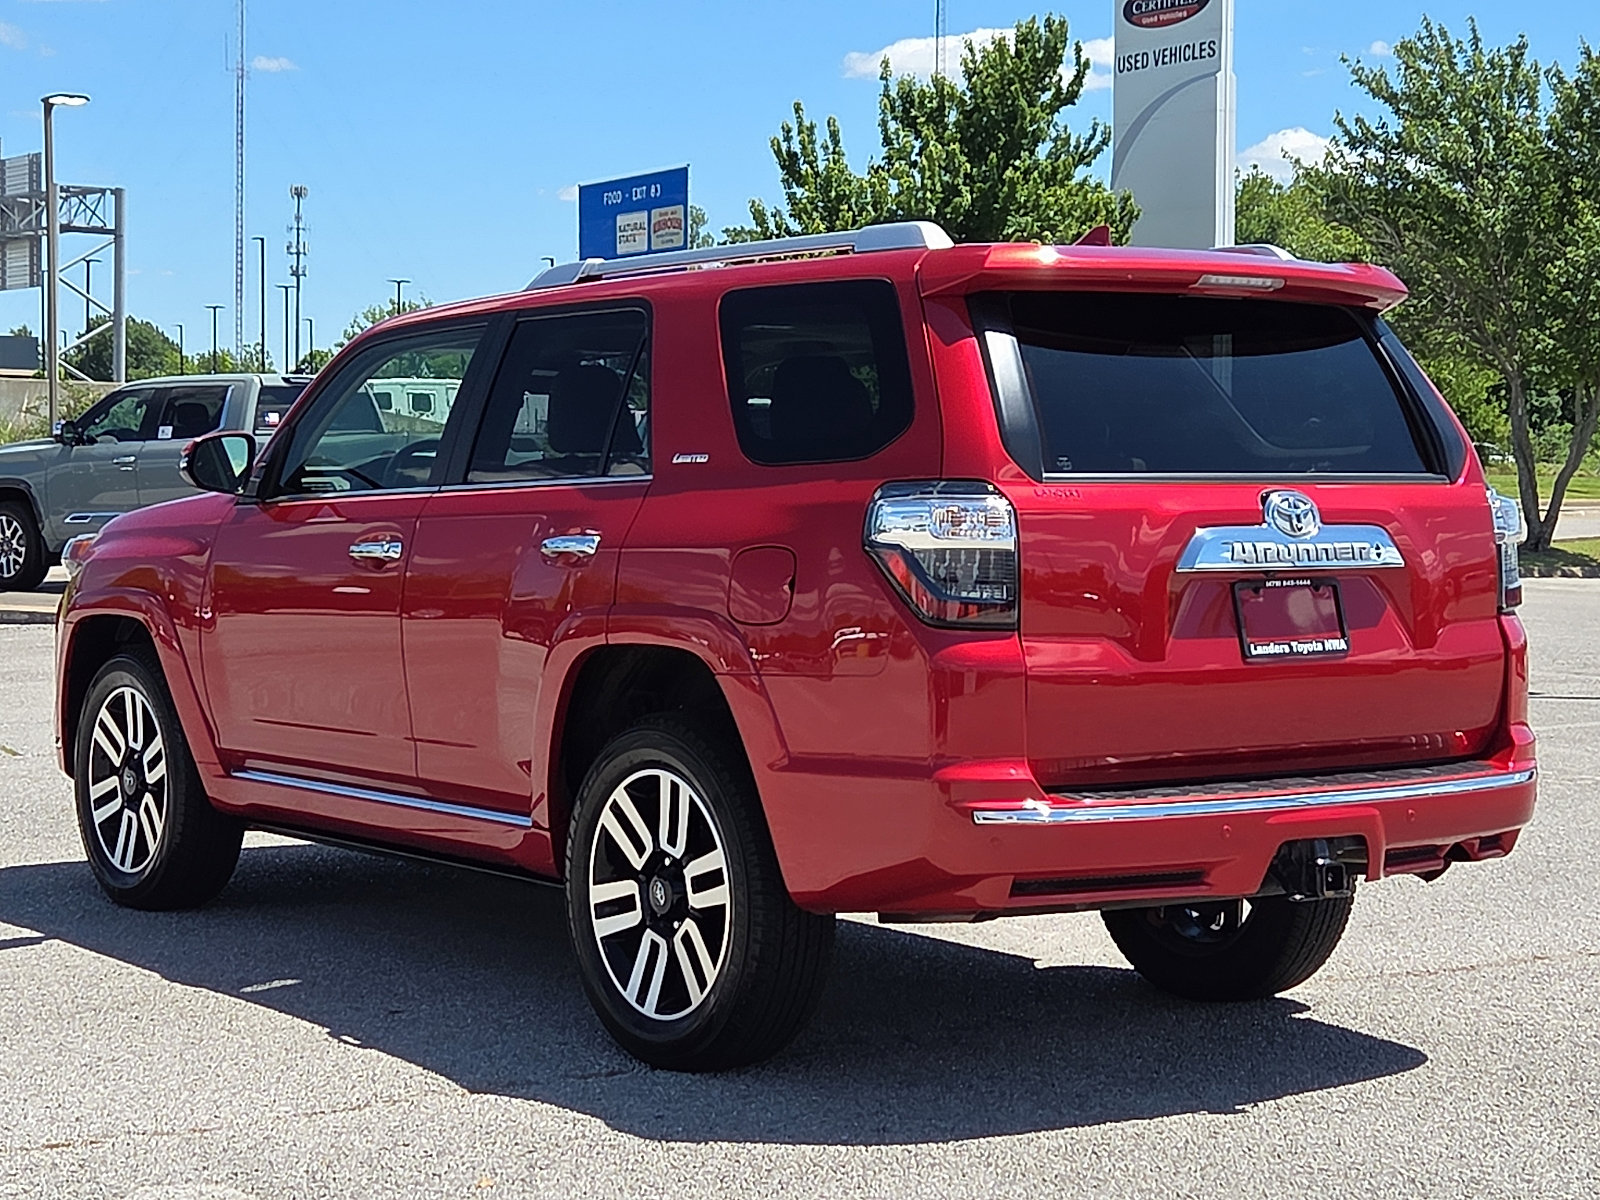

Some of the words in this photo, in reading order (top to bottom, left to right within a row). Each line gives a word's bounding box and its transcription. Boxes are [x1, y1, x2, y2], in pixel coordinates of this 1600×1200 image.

[1141, 15, 1158, 24] Used
[1159, 10, 1188, 21] Vehicles
[1117, 52, 1149, 73] USED
[1153, 40, 1217, 67] VEHICLES
[603, 190, 622, 205] FOOD
[632, 185, 647, 201] EXIT
[618, 221, 646, 233] NATURAL
[618, 234, 637, 245] STATE
[1250, 642, 1290, 655] Landers
[1290, 640, 1323, 654] Toyota
[1324, 639, 1347, 651] NWA
